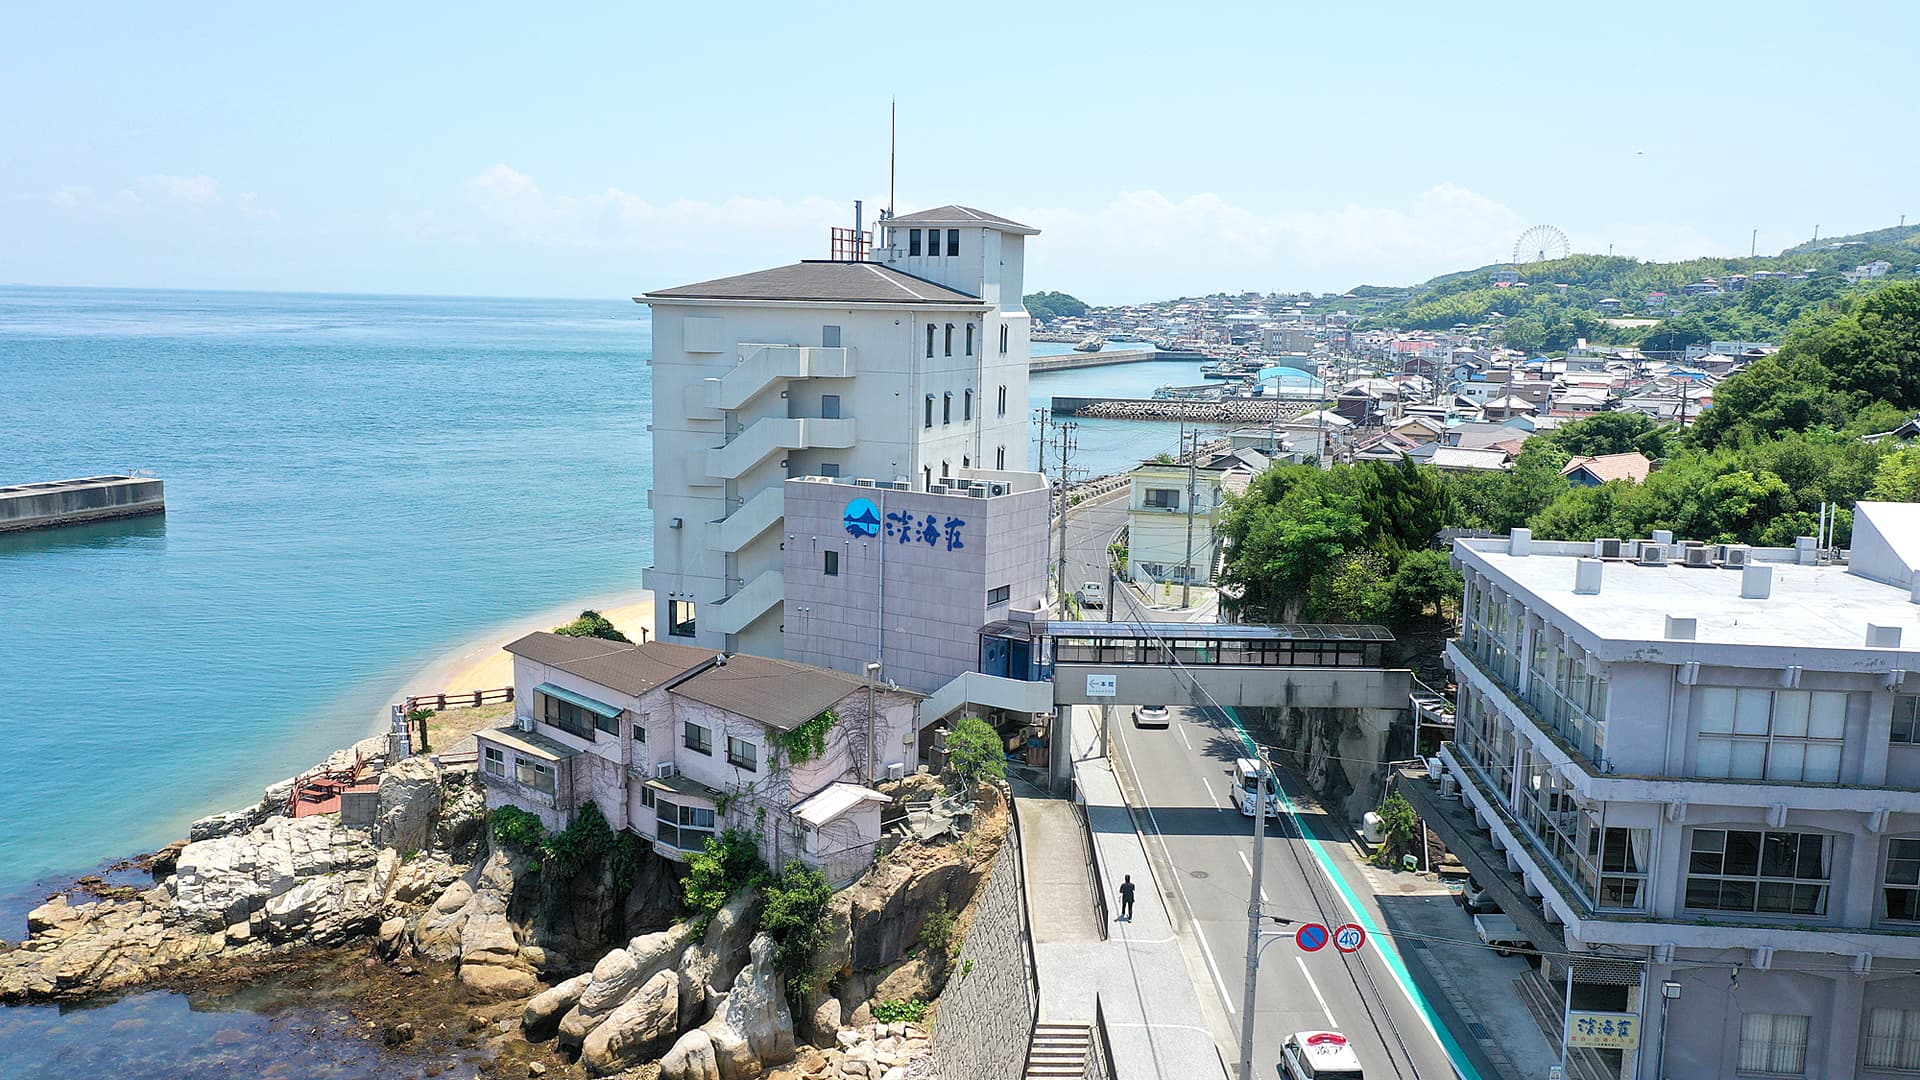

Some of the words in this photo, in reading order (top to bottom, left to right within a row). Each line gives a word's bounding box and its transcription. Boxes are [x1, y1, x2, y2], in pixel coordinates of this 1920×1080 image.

[886, 510, 966, 552] 淡海荘
[1339, 930, 1360, 946] 40
[1577, 1017, 1632, 1037] 淡海荘
